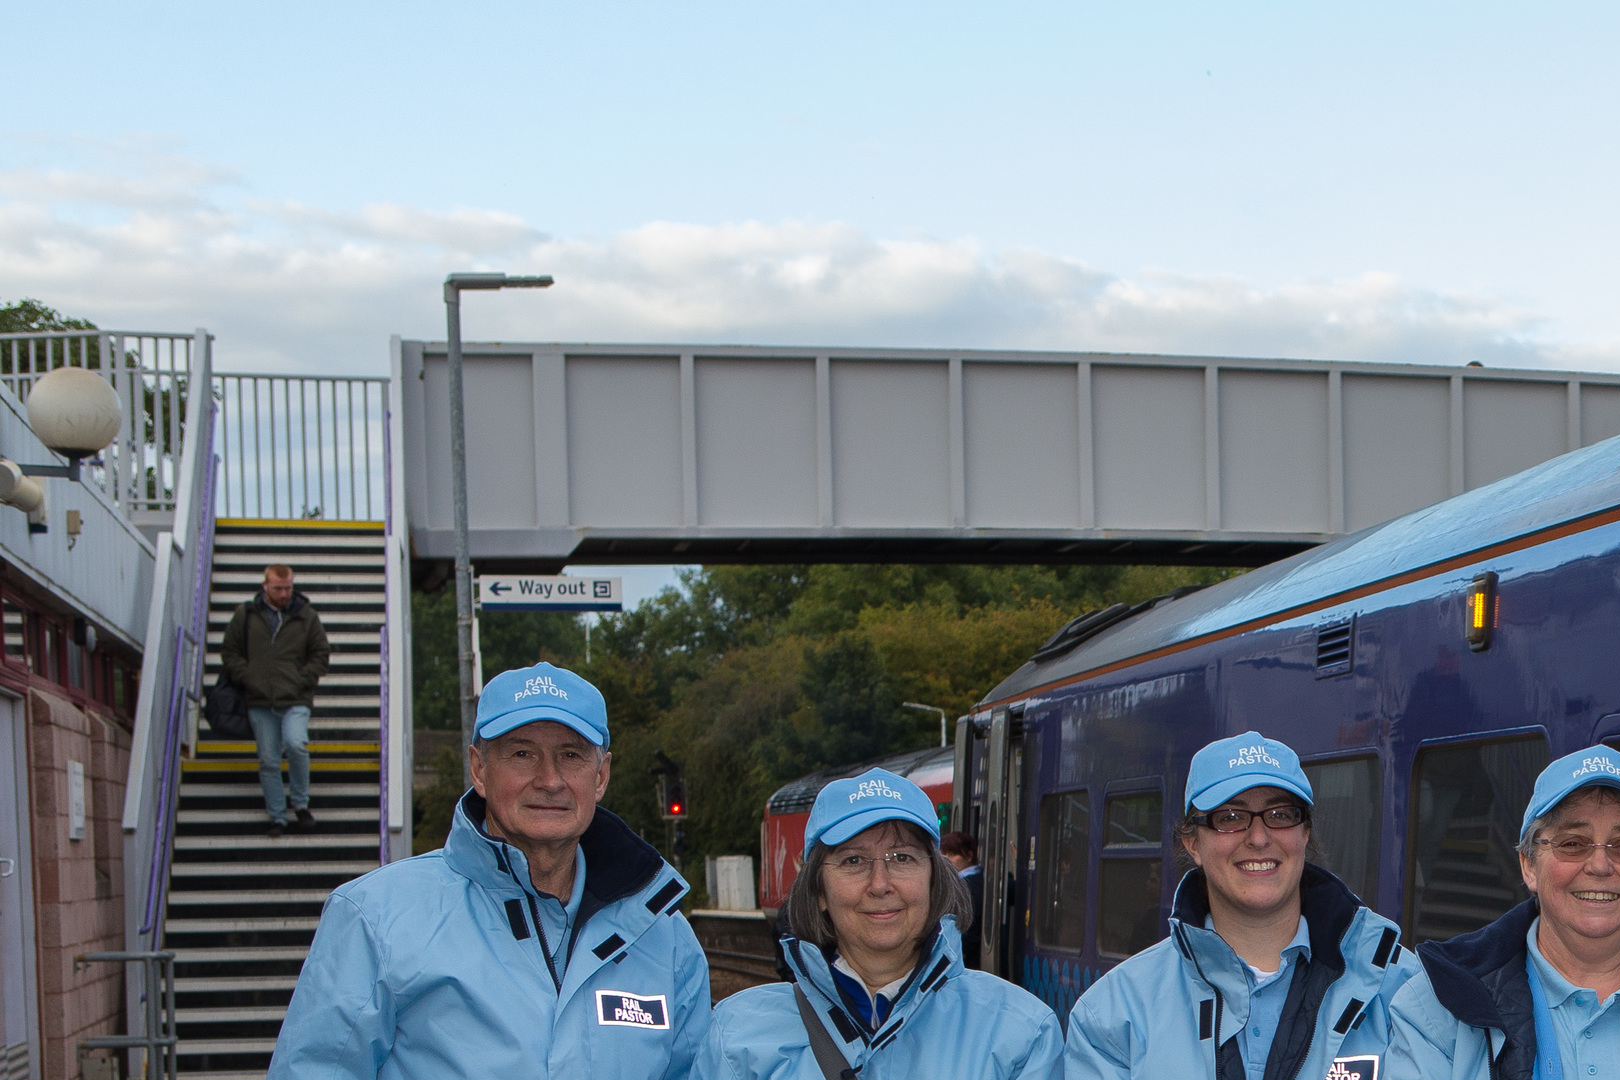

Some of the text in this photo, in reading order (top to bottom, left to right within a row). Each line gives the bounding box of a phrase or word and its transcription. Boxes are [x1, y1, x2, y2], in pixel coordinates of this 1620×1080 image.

[519, 580, 586, 598] Way out
[525, 676, 557, 689] RAIL
[514, 685, 569, 702] PASTOR
[1239, 745, 1269, 757] RAIL
[1229, 754, 1281, 769] PASTOR
[1583, 756, 1614, 767] RAIL
[859, 780, 890, 791] RAIL
[849, 788, 902, 804] PASTOR
[621, 997, 644, 1012] RAIL
[614, 1007, 655, 1025] PASTOR
[1328, 1062, 1350, 1074] AIL
